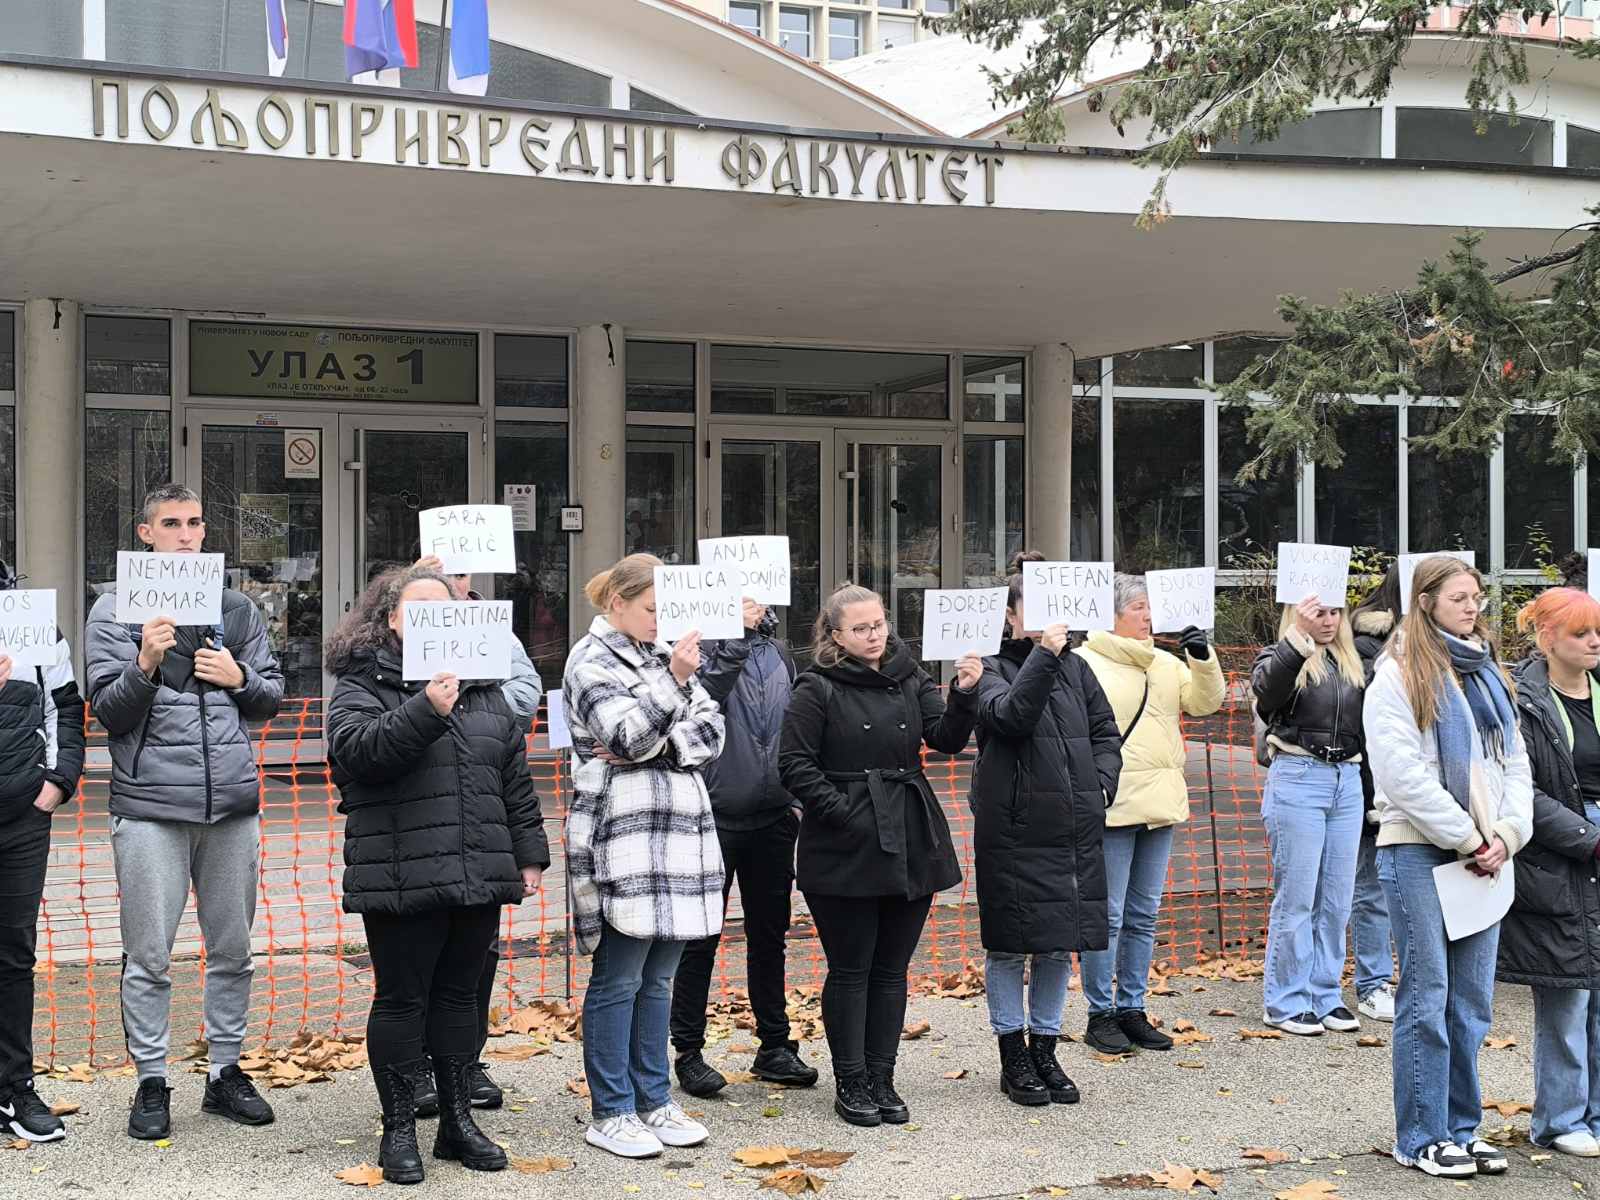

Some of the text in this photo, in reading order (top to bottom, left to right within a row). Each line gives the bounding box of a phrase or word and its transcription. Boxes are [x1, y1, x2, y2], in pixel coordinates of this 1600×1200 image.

[92, 77, 1006, 204] ПОЉОПРИВРЕДНИ ФАКУЛТЕТ
[338, 332, 425, 345] ПОЉОПРИВРЕДНИ
[247, 348, 423, 385] УЛАЗ 1
[437, 509, 486, 527] SARA
[663, 571, 727, 591] MILICA
[1034, 566, 1109, 588] STEFAN
[3, 591, 32, 613] OŠ
[128, 589, 208, 610] KOMAR
[1047, 593, 1099, 618] HRKA
[408, 605, 509, 629] VALENTINA
